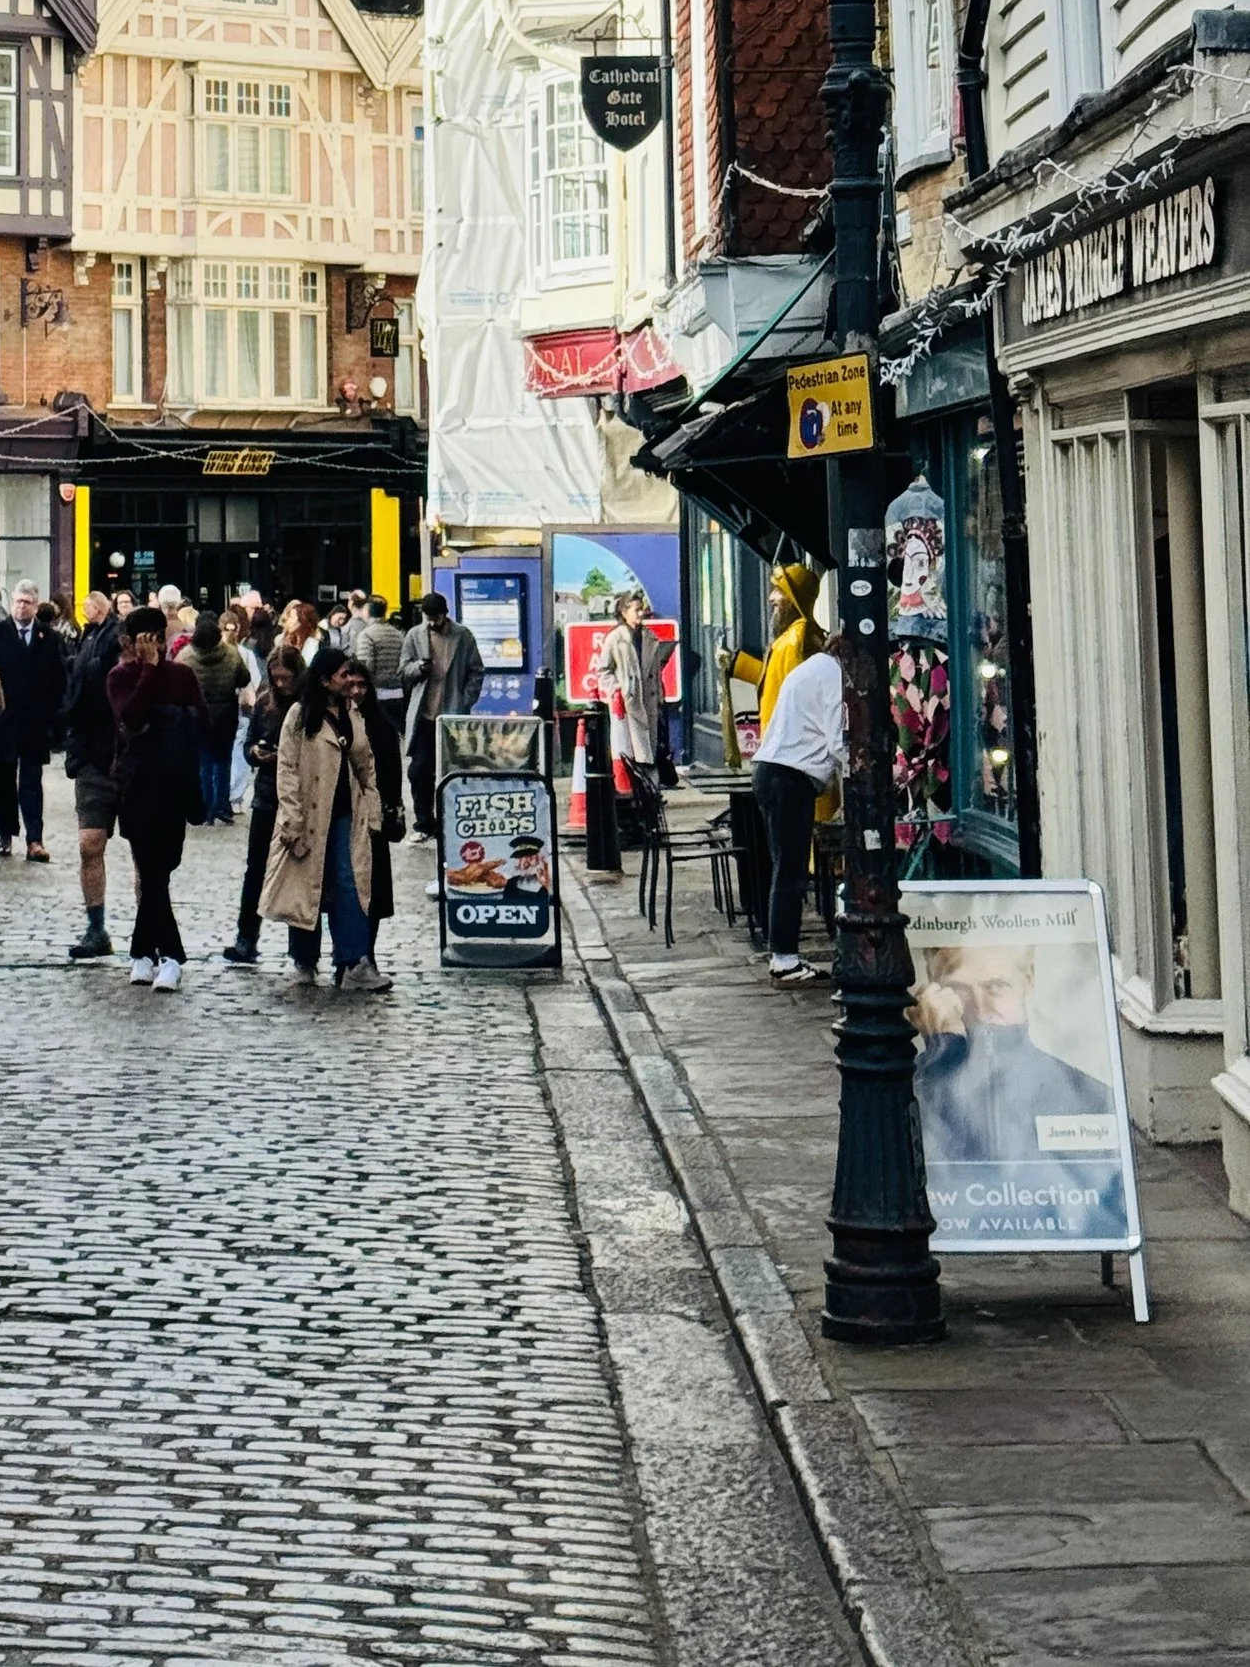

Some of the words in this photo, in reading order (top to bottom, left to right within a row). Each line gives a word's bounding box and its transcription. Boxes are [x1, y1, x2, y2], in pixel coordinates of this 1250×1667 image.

[588, 68, 660, 86] Cathedral
[606, 89, 643, 105] Gate
[604, 110, 647, 128] Hotel
[1022, 246, 1062, 327] JAMES
[1063, 217, 1126, 312] PRINGLE
[1129, 176, 1216, 287] WEAVERS
[788, 370, 839, 390] Pedestrian
[841, 365, 866, 382] Zone
[831, 400, 843, 417] At
[844, 399, 862, 416] any
[837, 420, 859, 437] time
[456, 792, 536, 818] FISH
[457, 816, 536, 837] CHIPS
[457, 905, 539, 925] OPEN
[980, 914, 1040, 930] Woollen
[1046, 909, 1077, 927] Mill
[965, 1182, 1100, 1207] Collection
[940, 1217, 971, 1231] OW
[978, 1217, 1079, 1232] AVAILABLE
